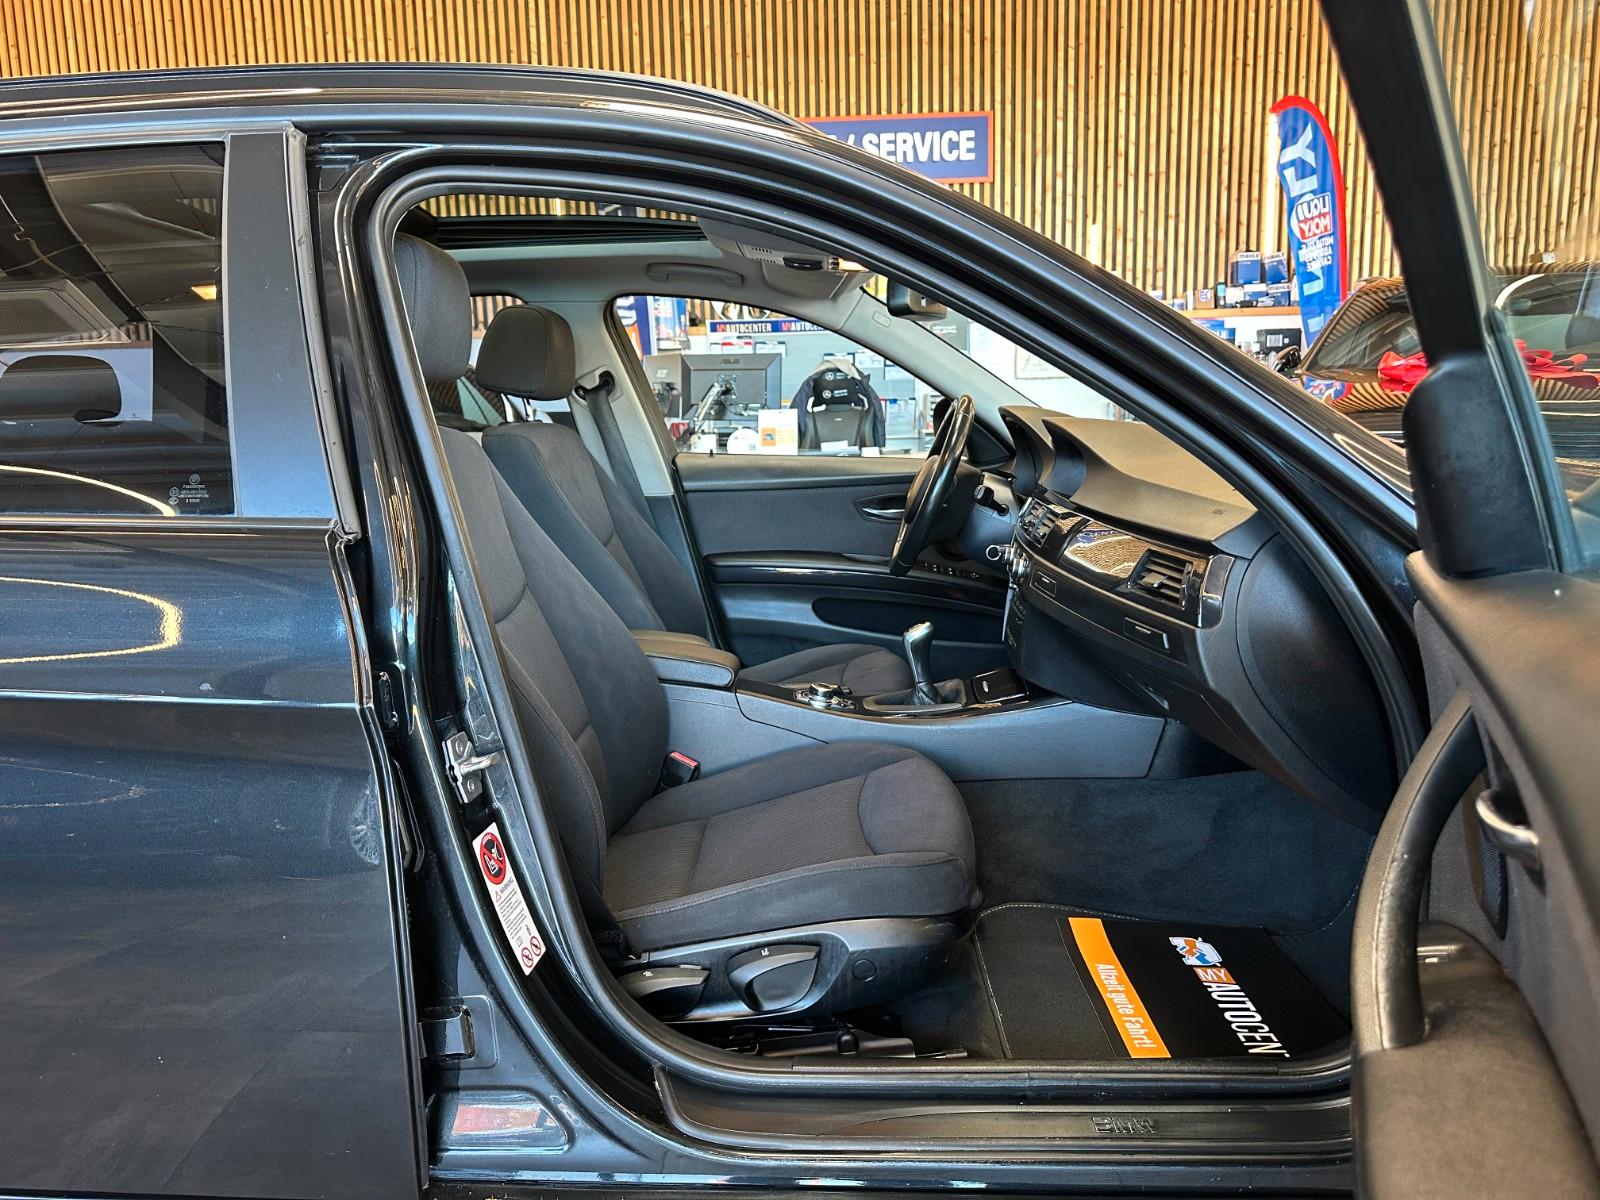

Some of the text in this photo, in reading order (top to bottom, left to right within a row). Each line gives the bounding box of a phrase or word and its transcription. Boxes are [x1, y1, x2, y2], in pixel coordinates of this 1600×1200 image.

[861, 130, 976, 163] SERVICE
[1095, 963, 1158, 1048] Allzeit gute Fahrt!
[1202, 981, 1291, 1058] AUTOCEN
[1090, 1116, 1158, 1134] BMW
